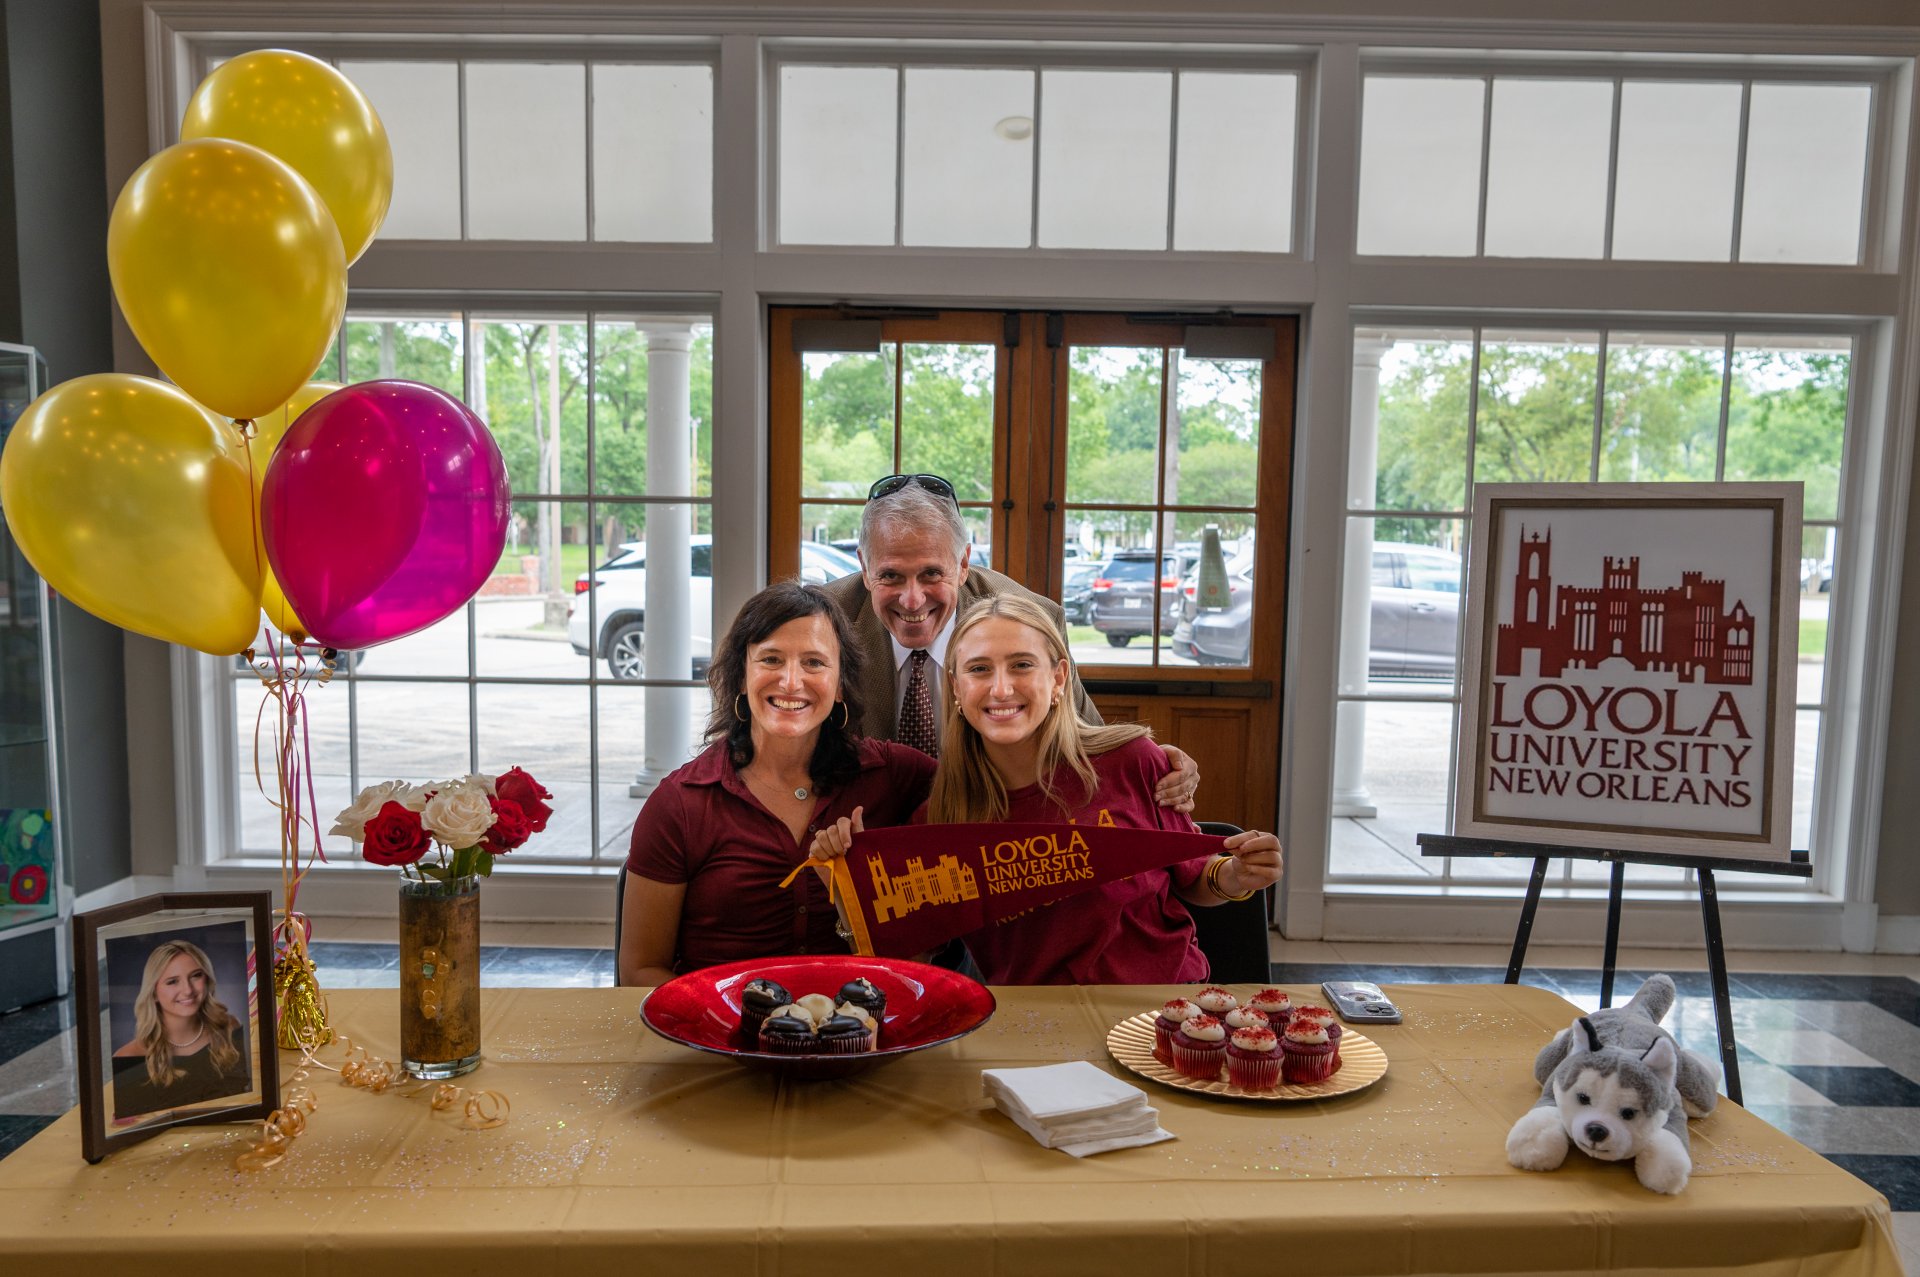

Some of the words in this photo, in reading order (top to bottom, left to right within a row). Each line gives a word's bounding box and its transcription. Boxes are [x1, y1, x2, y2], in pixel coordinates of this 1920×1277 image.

[1490, 682, 1753, 740] LOYOLA
[1490, 732, 1753, 777] UNIVERSITY
[1488, 766, 1572, 797] NEW
[1575, 771, 1752, 808] ORLEANS
[979, 830, 1090, 868] LOYOLA
[984, 851, 1091, 882] UNIVERSITY
[987, 876, 1024, 896] NEW
[1023, 866, 1095, 889] ORLEANS
